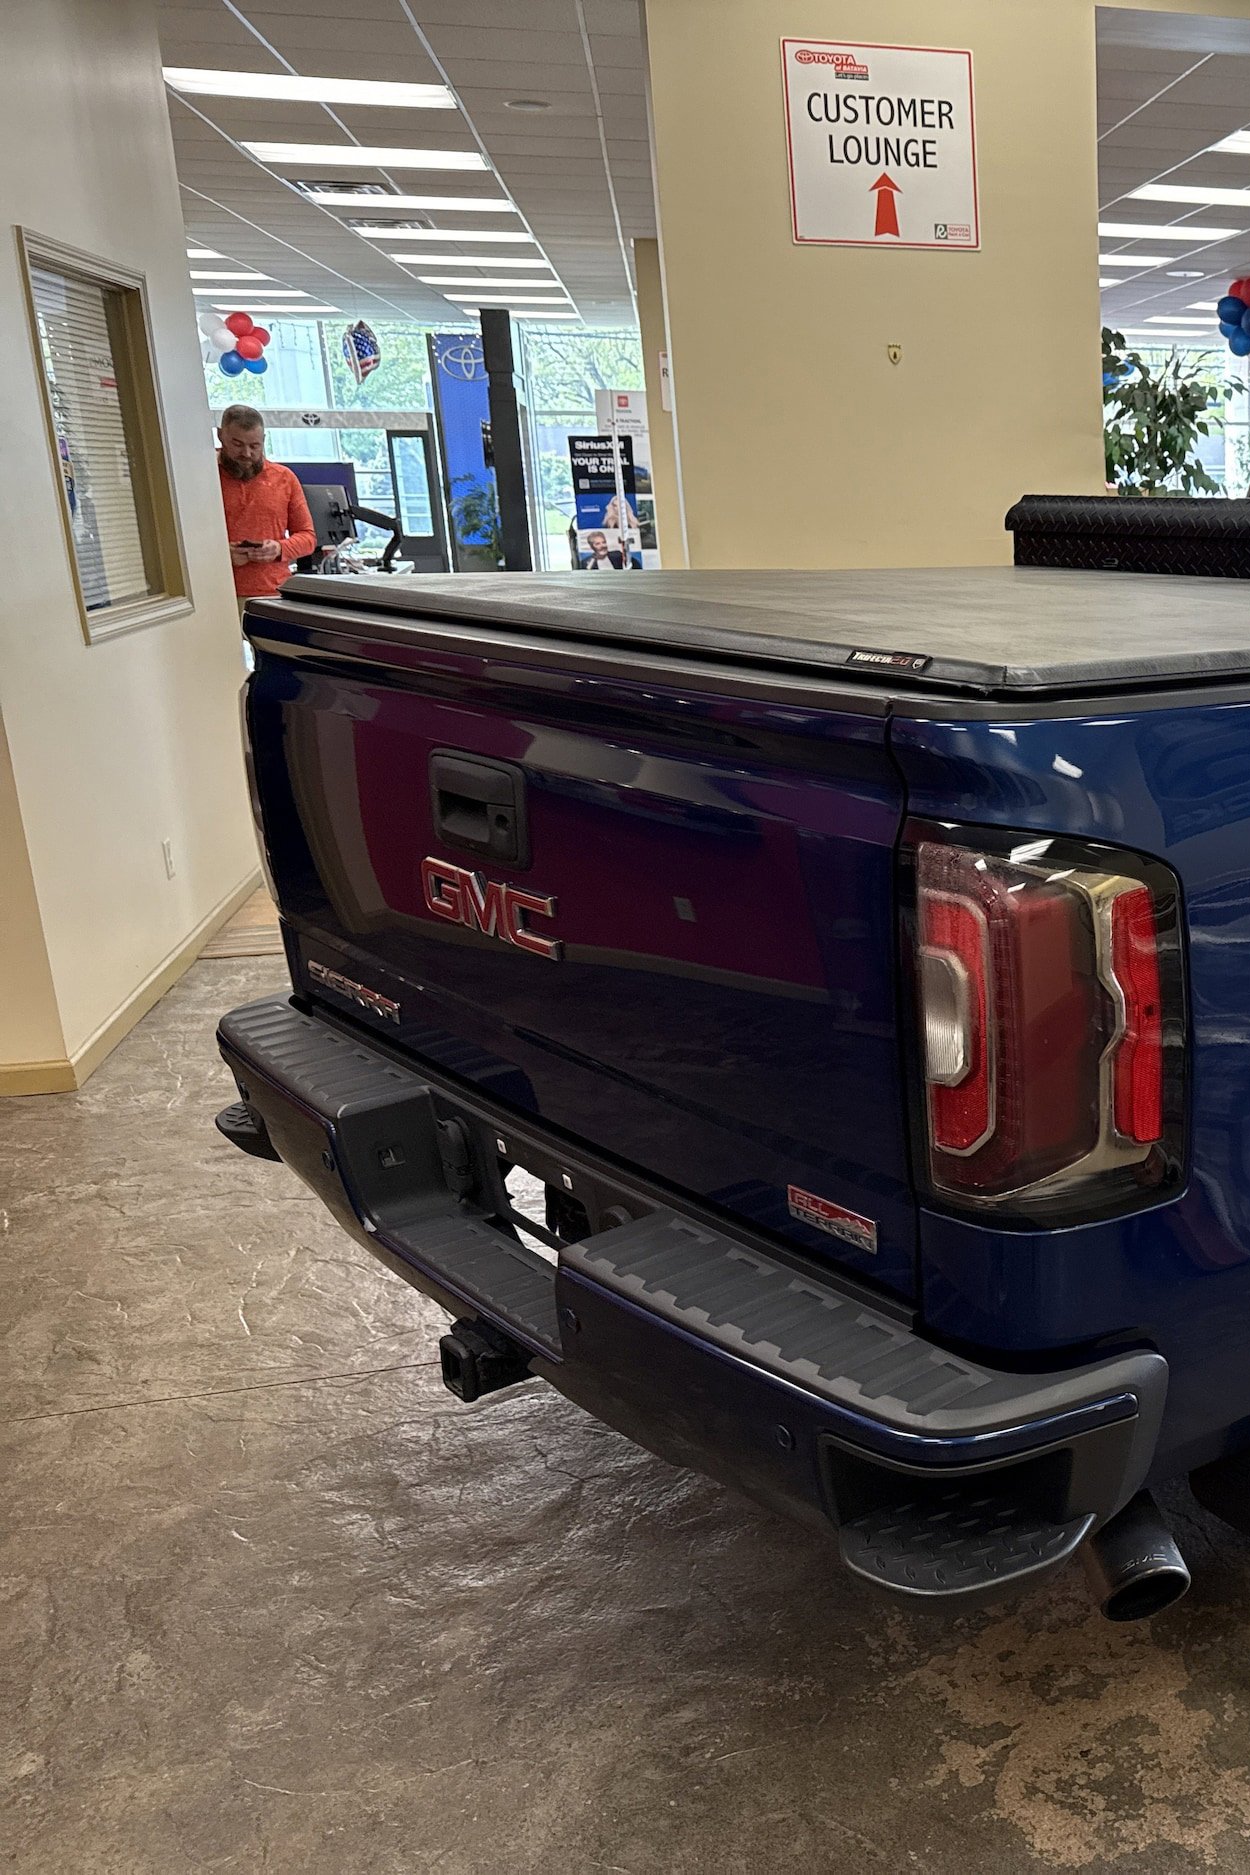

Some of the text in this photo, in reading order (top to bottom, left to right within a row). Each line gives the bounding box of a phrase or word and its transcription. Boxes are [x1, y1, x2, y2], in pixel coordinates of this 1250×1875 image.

[813, 53, 855, 65] TOYOTA
[807, 92, 954, 130] CUSTOMER
[828, 134, 938, 168] LOUNGE
[571, 457, 630, 466] YOUR TRAL
[588, 464, 615, 473] IS ON
[421, 856, 564, 962] GMC
[307, 959, 401, 1026] SIERRA
[794, 1192, 830, 1217] ALL
[789, 1205, 875, 1253] TERRAIN
